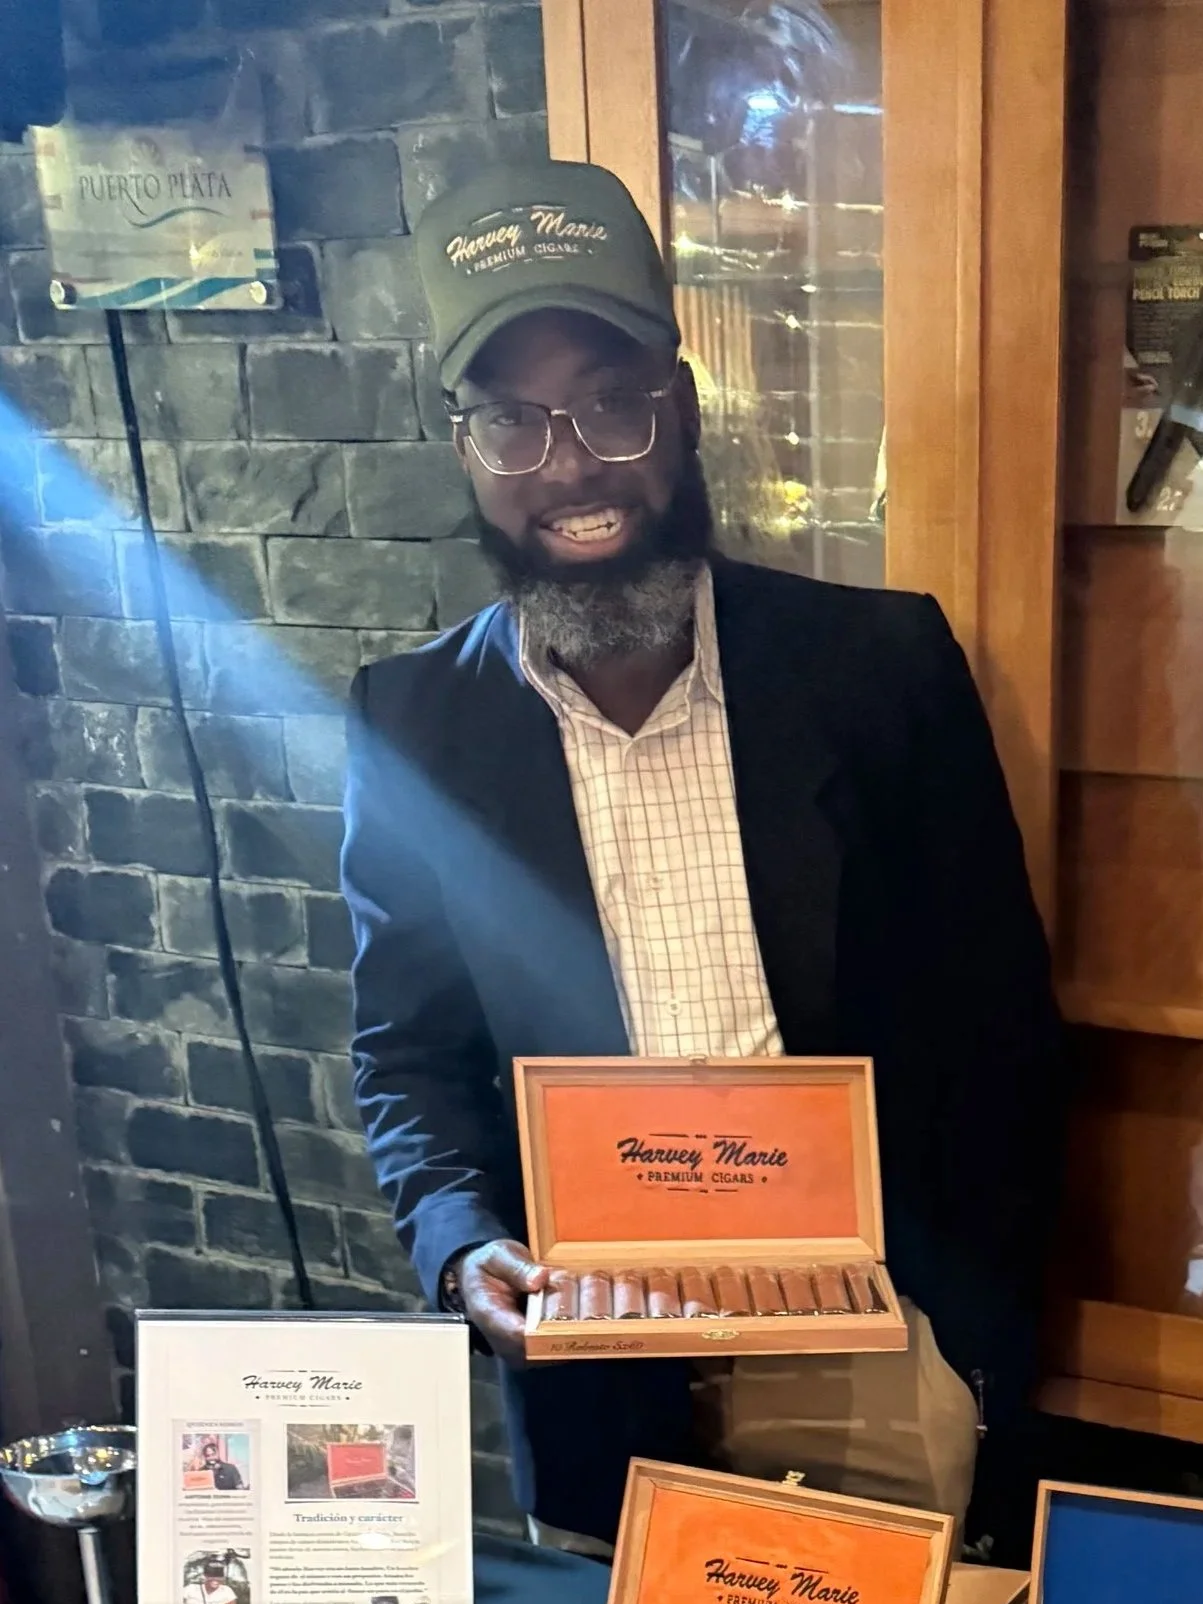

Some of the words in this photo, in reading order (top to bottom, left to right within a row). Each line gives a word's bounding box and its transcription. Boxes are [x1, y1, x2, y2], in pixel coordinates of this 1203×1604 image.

[79, 173, 160, 216] PUERTO
[168, 171, 232, 199] PLATA
[447, 223, 522, 267] Harvey
[530, 211, 608, 241] Marie
[474, 245, 526, 273] PREMIUM
[1167, 285, 1200, 300] TORCH
[617, 1137, 703, 1171] Harvey
[713, 1140, 788, 1167] Marie
[647, 1171, 703, 1183] PREMIUM
[711, 1173, 754, 1184] CIGARS
[242, 1375, 302, 1393] Harvey
[309, 1375, 363, 1390] Marie
[293, 1512, 347, 1523] Tradición
[348, 1515, 355, 1525] y
[356, 1513, 404, 1523] carácter
[704, 1558, 781, 1599] Harvey
